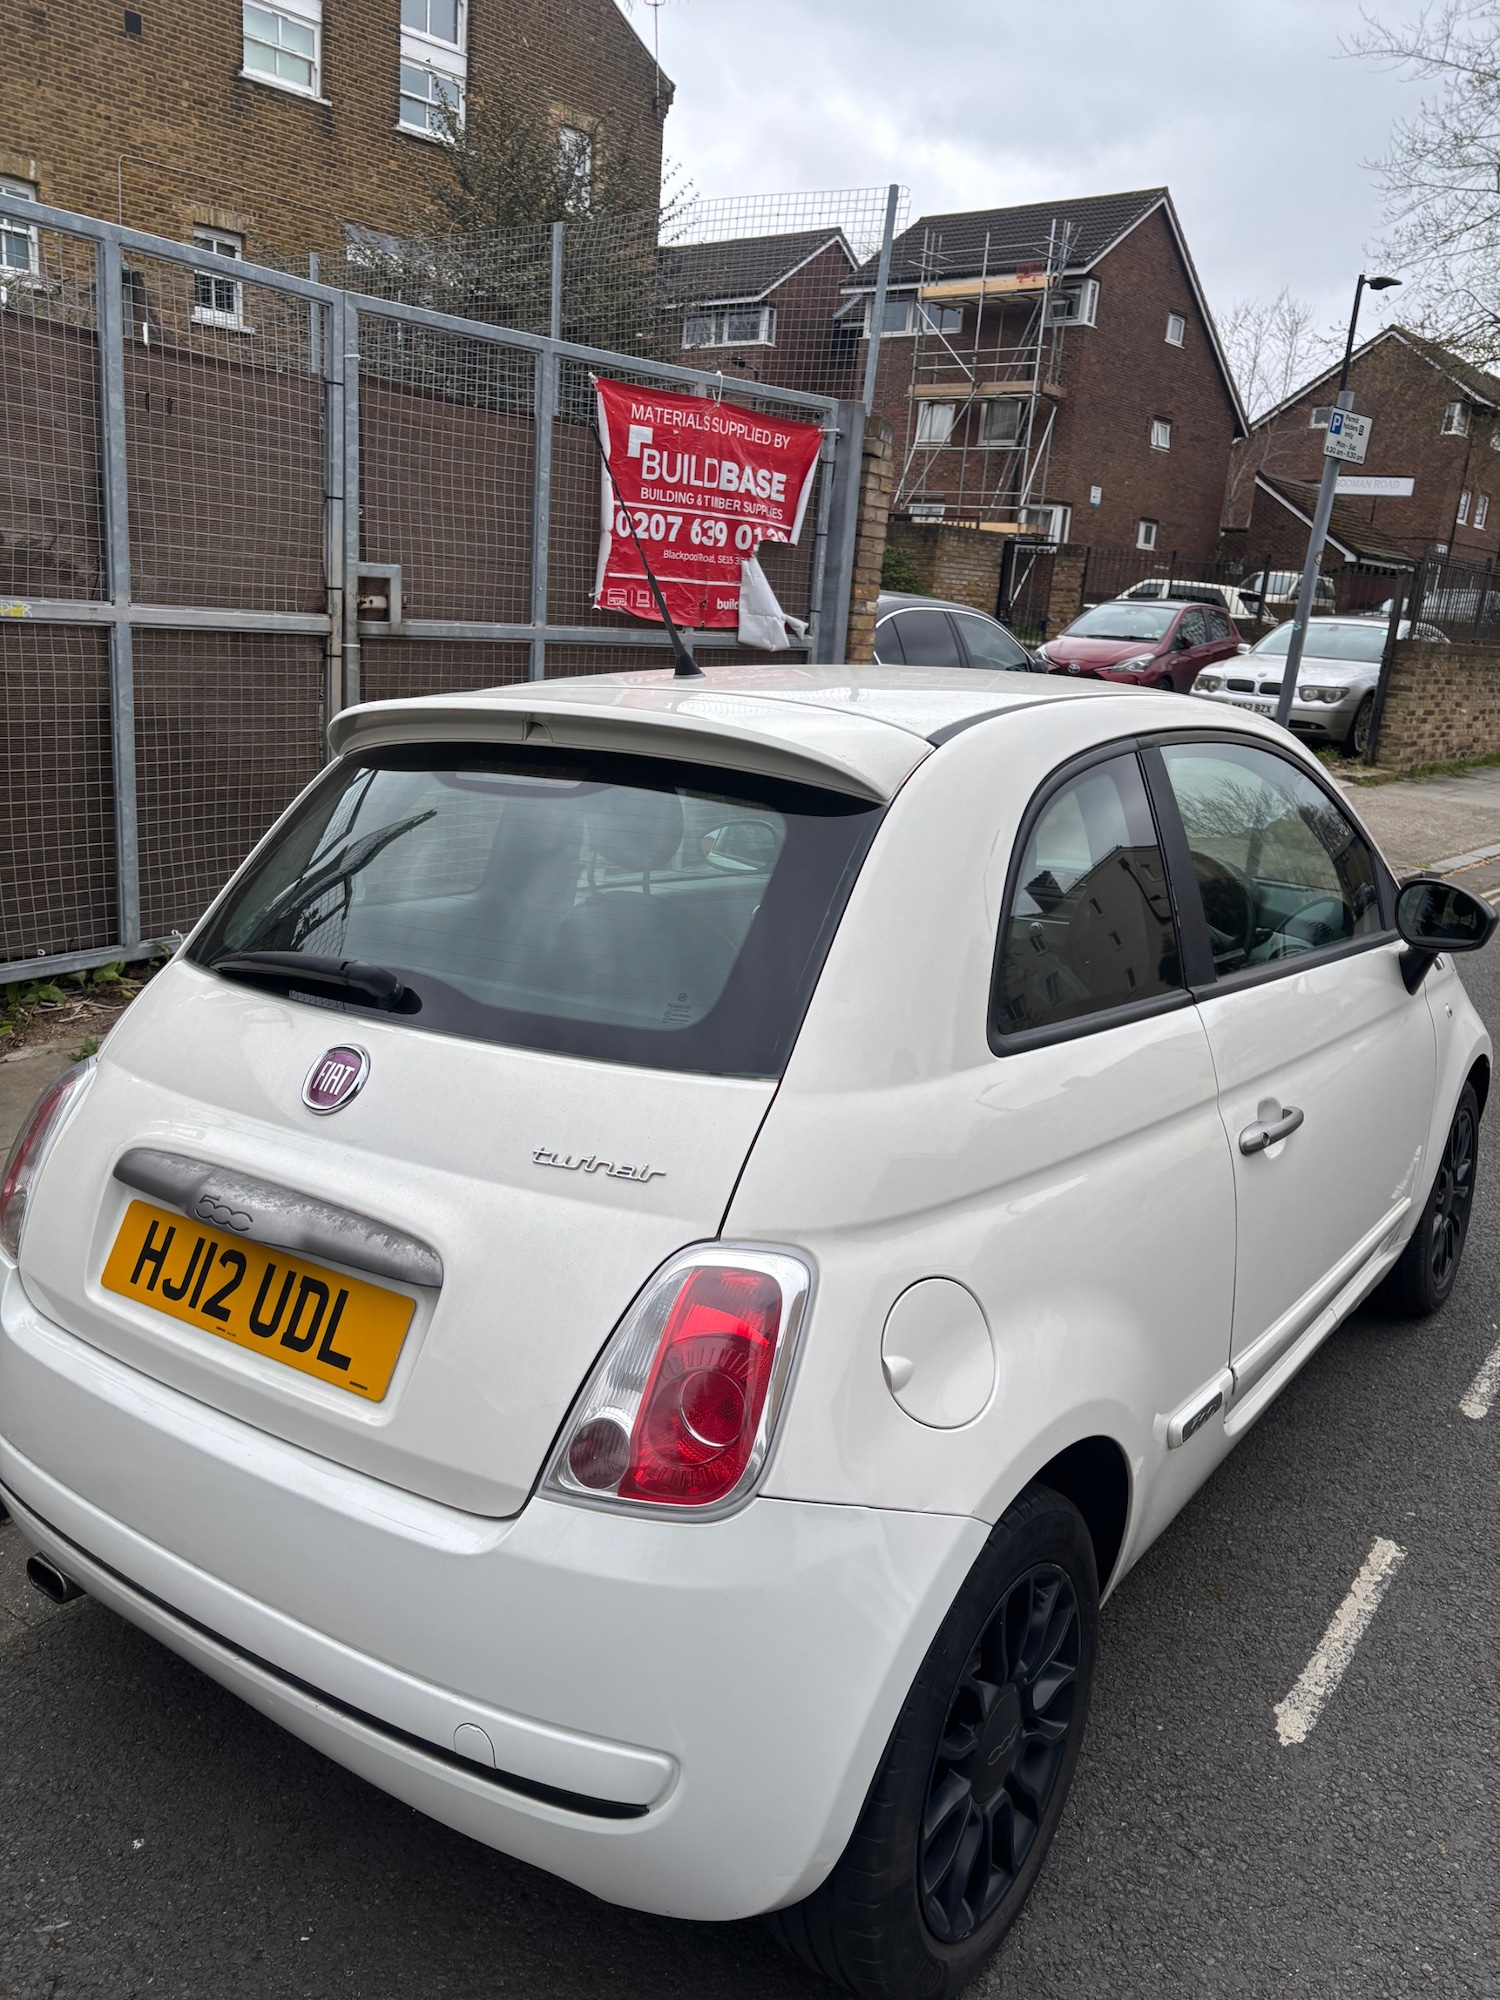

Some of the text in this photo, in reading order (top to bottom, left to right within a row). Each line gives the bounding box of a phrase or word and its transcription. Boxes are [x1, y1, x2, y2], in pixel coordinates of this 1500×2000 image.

[631, 402, 791, 450] MATERIALS SUPPLIED BY
[1343, 422, 1358, 432] holders
[1345, 414, 1360, 424] Permit
[1336, 440, 1346, 449] Mon
[1348, 443, 1357, 451] Sat
[1344, 431, 1354, 440] only
[640, 447, 788, 503] BUILDBASE
[1374, 479, 1400, 489] ROAD
[640, 486, 695, 505] BUILDING
[696, 494, 703, 506] &
[743, 501, 783, 521] SUPPLIES
[615, 510, 683, 543] 0207
[690, 518, 728, 548] 639
[717, 554, 734, 565] SE15
[1254, 702, 1272, 714] BZX
[313, 1060, 356, 1096] FIAT
[532, 1146, 667, 1183] twinair
[130, 1219, 352, 1372] HJ12 UDL
